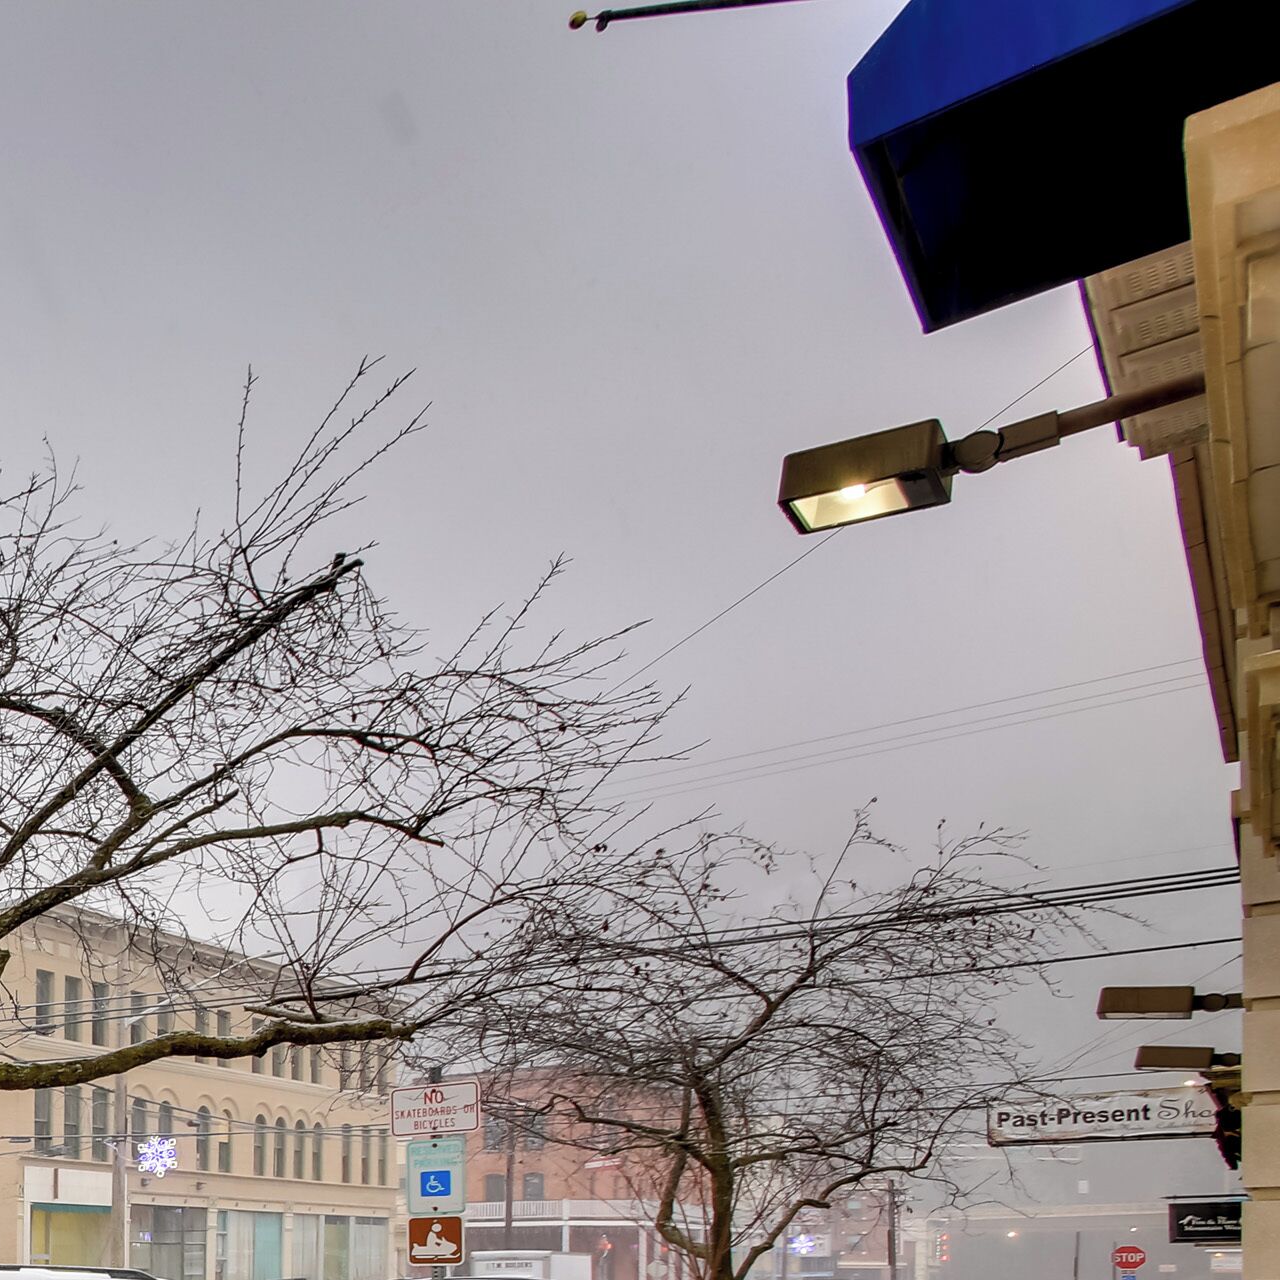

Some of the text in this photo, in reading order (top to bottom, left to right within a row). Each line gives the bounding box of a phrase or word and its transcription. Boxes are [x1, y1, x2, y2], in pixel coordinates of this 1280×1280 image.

[423, 1090, 445, 1105] NO
[394, 1105, 458, 1120] SKATEBOARDS
[996, 1103, 1151, 1128] Past-Present
[413, 1118, 456, 1130] BICYCLES
[1114, 1252, 1144, 1263] STOP
